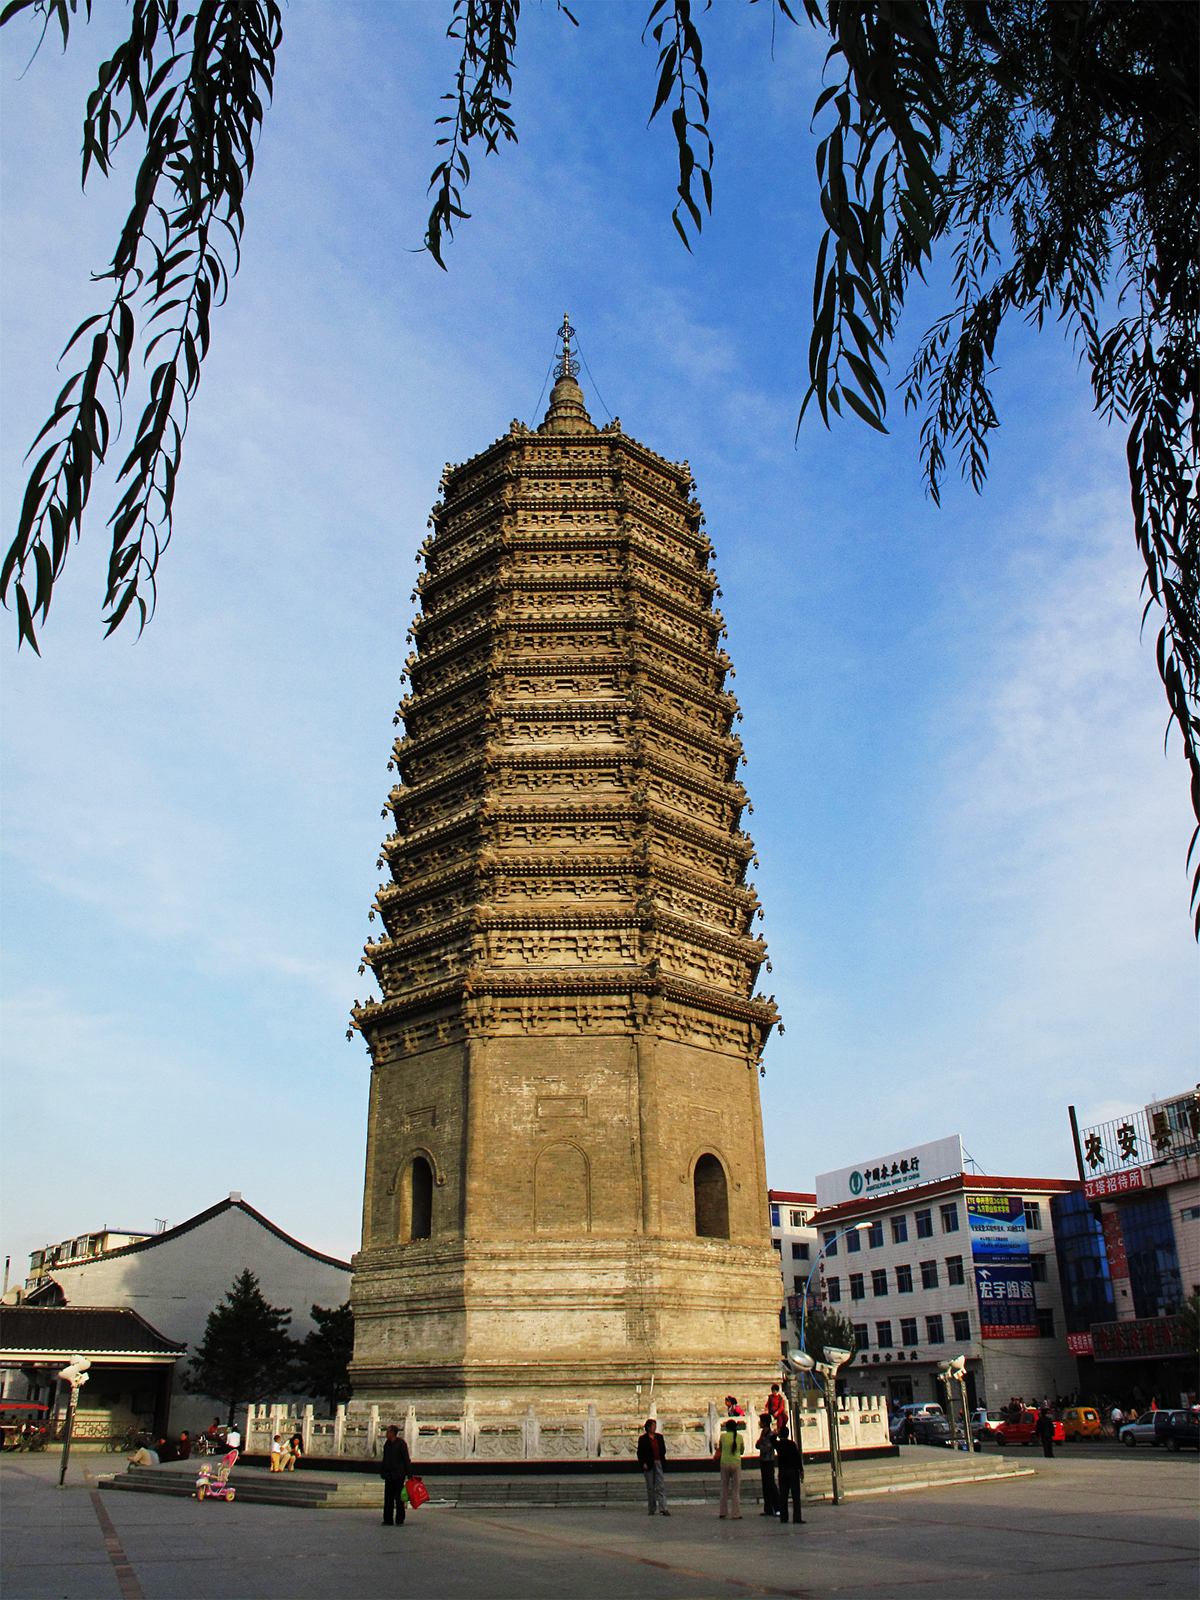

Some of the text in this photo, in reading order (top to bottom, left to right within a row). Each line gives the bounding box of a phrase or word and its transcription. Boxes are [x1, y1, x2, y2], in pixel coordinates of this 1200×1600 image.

[863, 1156, 920, 1185] 中国农业银行
[1085, 1171, 1143, 1197] 辽塔招待所
[979, 1281, 1034, 1299] 宏宇陶瓷
